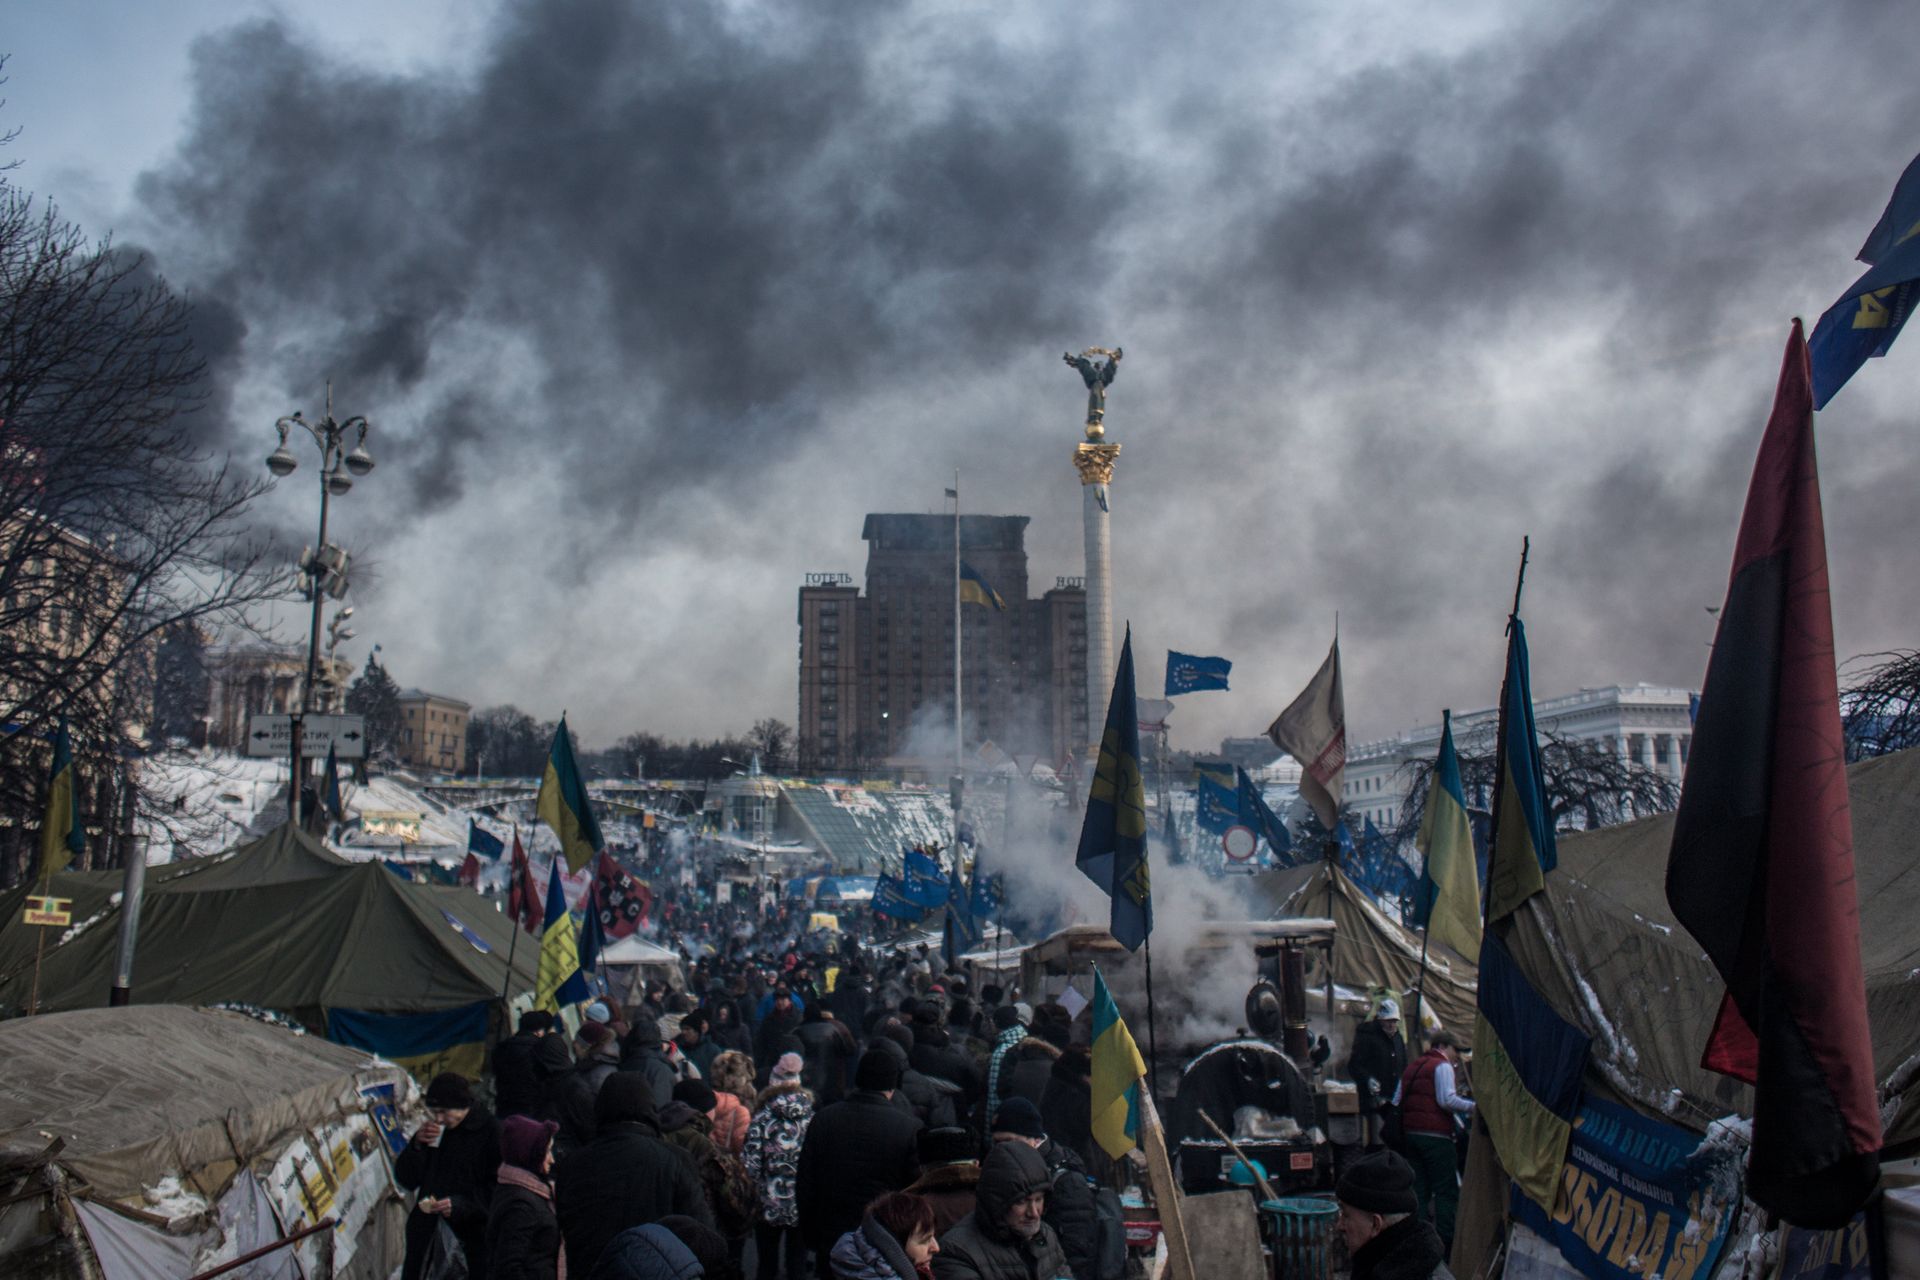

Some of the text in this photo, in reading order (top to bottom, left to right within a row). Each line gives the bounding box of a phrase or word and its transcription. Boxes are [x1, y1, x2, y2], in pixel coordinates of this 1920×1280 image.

[805, 573, 852, 584] ГОТЕЛЬ
[271, 731, 329, 740] ХРЕАТИК
[1619, 1122, 1681, 1170] ВИБІР
[1551, 1162, 1671, 1280] ОБОДА
